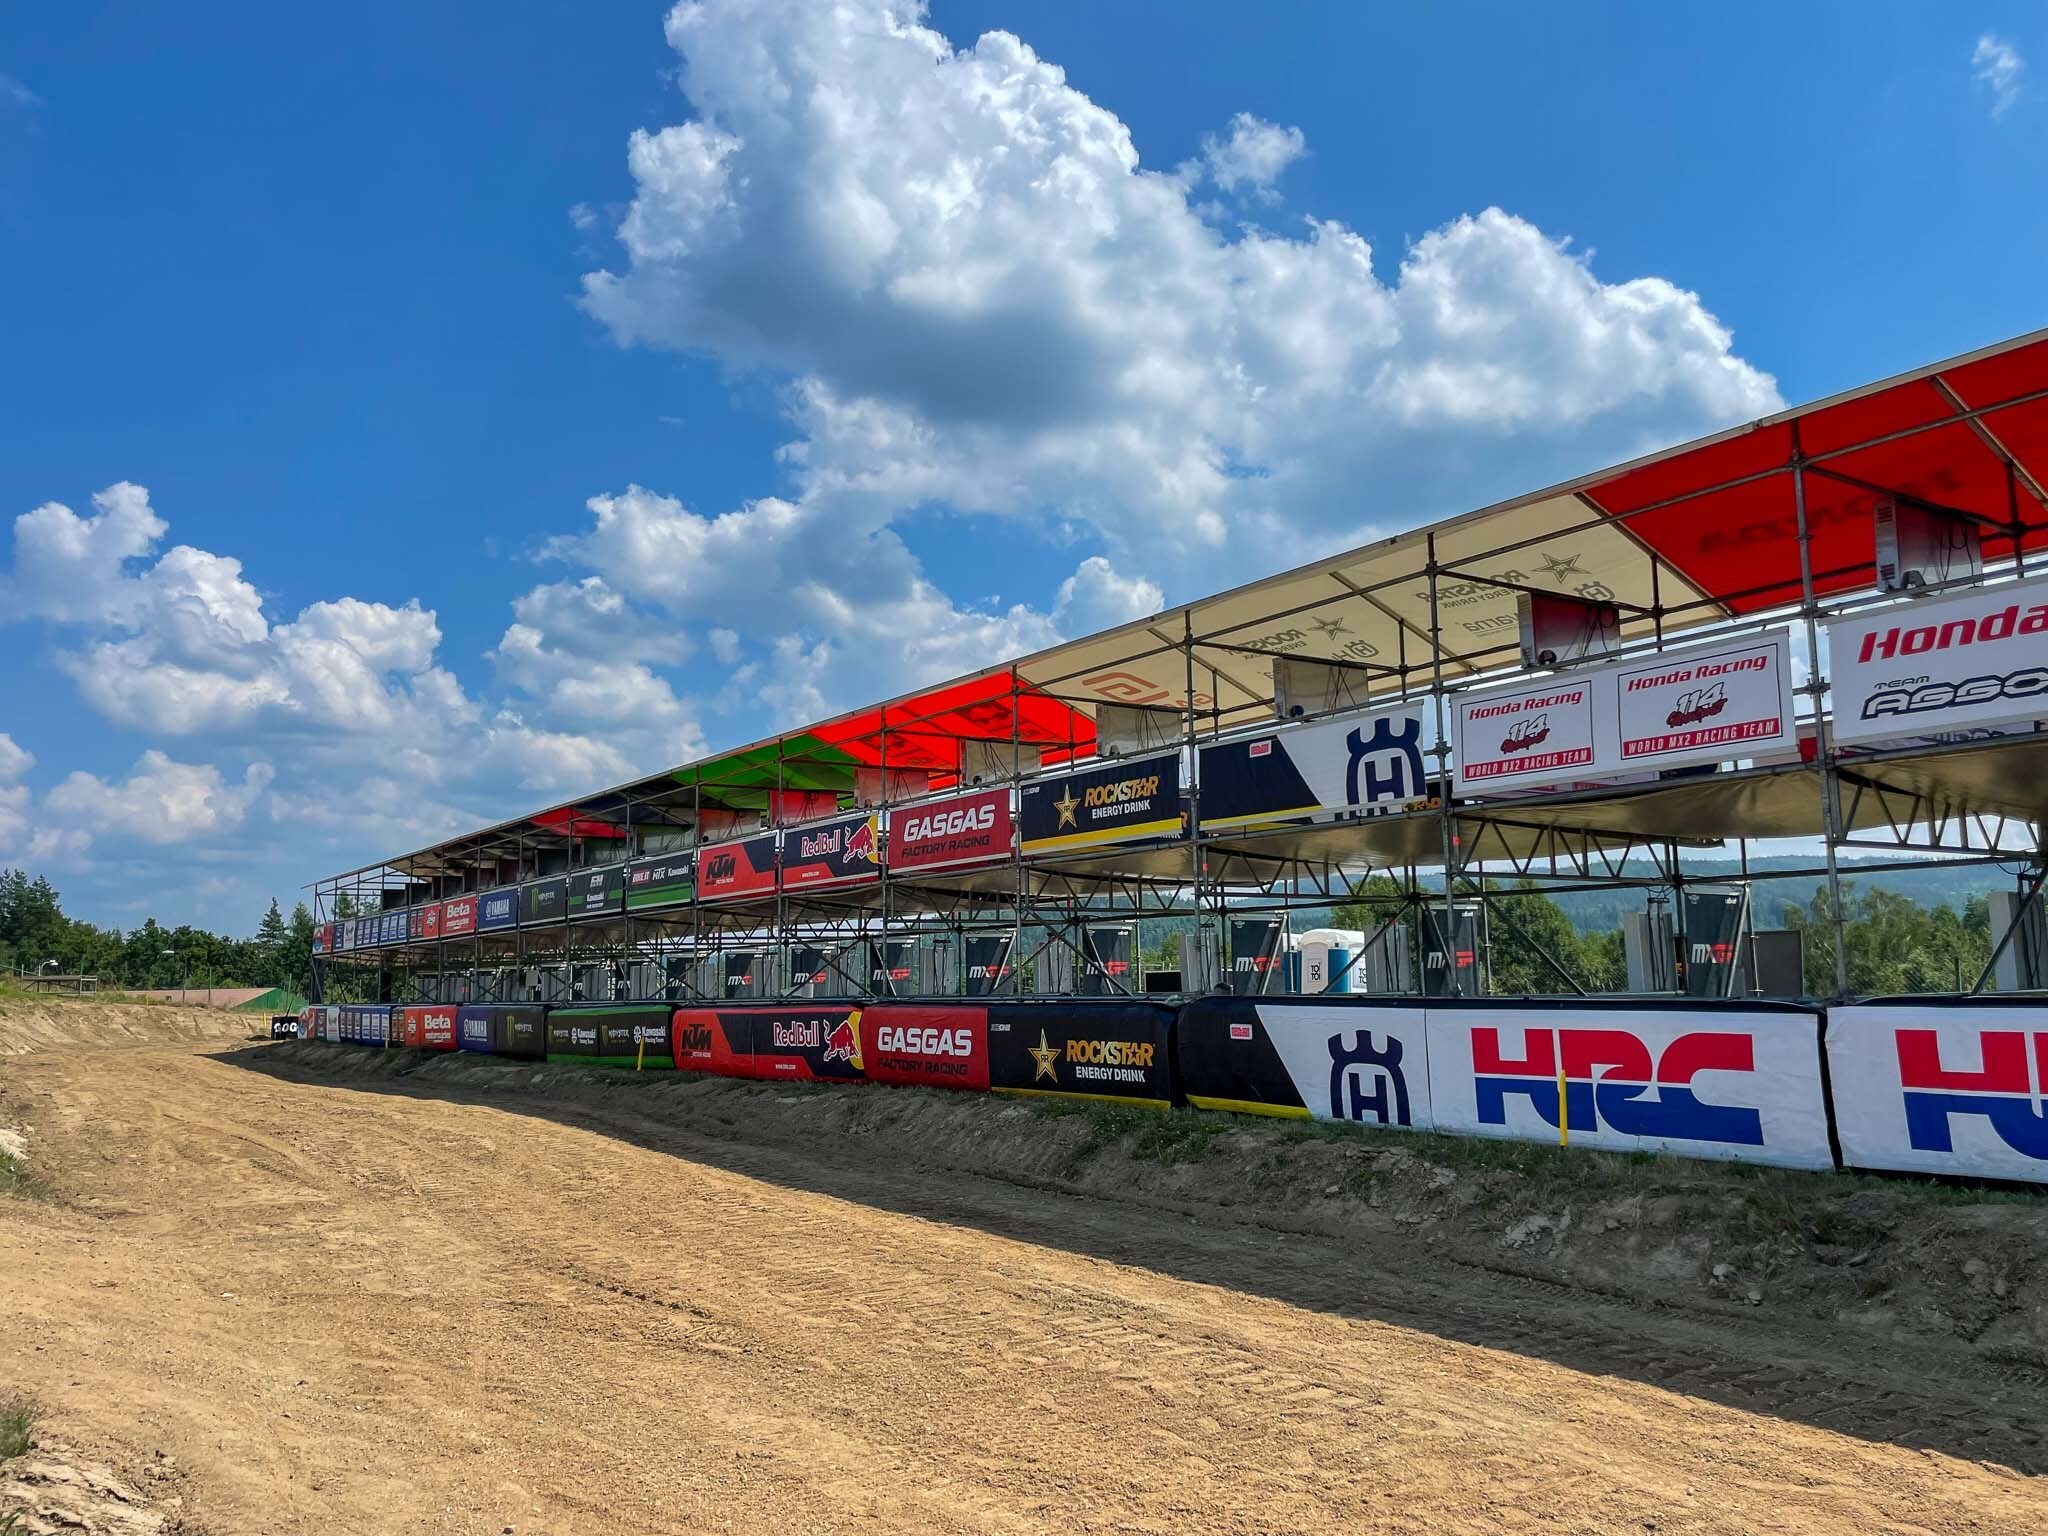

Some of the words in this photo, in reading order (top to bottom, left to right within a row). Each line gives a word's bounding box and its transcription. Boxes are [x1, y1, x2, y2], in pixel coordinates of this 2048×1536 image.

[1857, 604, 2048, 664] Honda
[1627, 670, 1691, 692] Honda
[1695, 655, 1768, 679] Racing
[1874, 675, 1930, 690] TEAM
[1469, 703, 1521, 720] Honda
[1524, 691, 1583, 710] Racing
[1676, 681, 1725, 715] 114
[1508, 713, 1548, 742] 114
[1628, 739, 1664, 754] WORLD
[1668, 733, 1691, 748] MX2
[1696, 727, 1737, 744] RACING
[1743, 720, 1775, 737] TEAM
[1468, 763, 1498, 777] WORLD
[1502, 760, 1520, 772] MX2
[1524, 754, 1558, 769] RACING
[1562, 750, 1588, 763] TEAM
[1084, 775, 1160, 807] ROCKSTAR
[1091, 804, 1124, 819] ENERGY
[1124, 799, 1151, 814] DRINK
[903, 804, 996, 842] GASGAS
[902, 842, 948, 858] FACTORY
[949, 834, 990, 851] RACING
[706, 852, 736, 879] KTM
[446, 902, 470, 918] Beta
[491, 899, 510, 915] YAMAHA
[424, 1014, 451, 1029] Beta
[470, 1019, 487, 1037] YAMAHA
[577, 1028, 597, 1038] Kawasaki
[642, 1025, 666, 1037] Kawasaki
[681, 1023, 712, 1050] KTM
[877, 1026, 972, 1057] GASGAS
[878, 1057, 923, 1073] FACTORY
[925, 1062, 968, 1076] RACING
[1066, 1039, 1154, 1067] ROCKSTAR
[1075, 1066, 1113, 1080] ENERGY
[1114, 1068, 1146, 1083] DRINK
[1470, 1027, 1765, 1146] HRC
